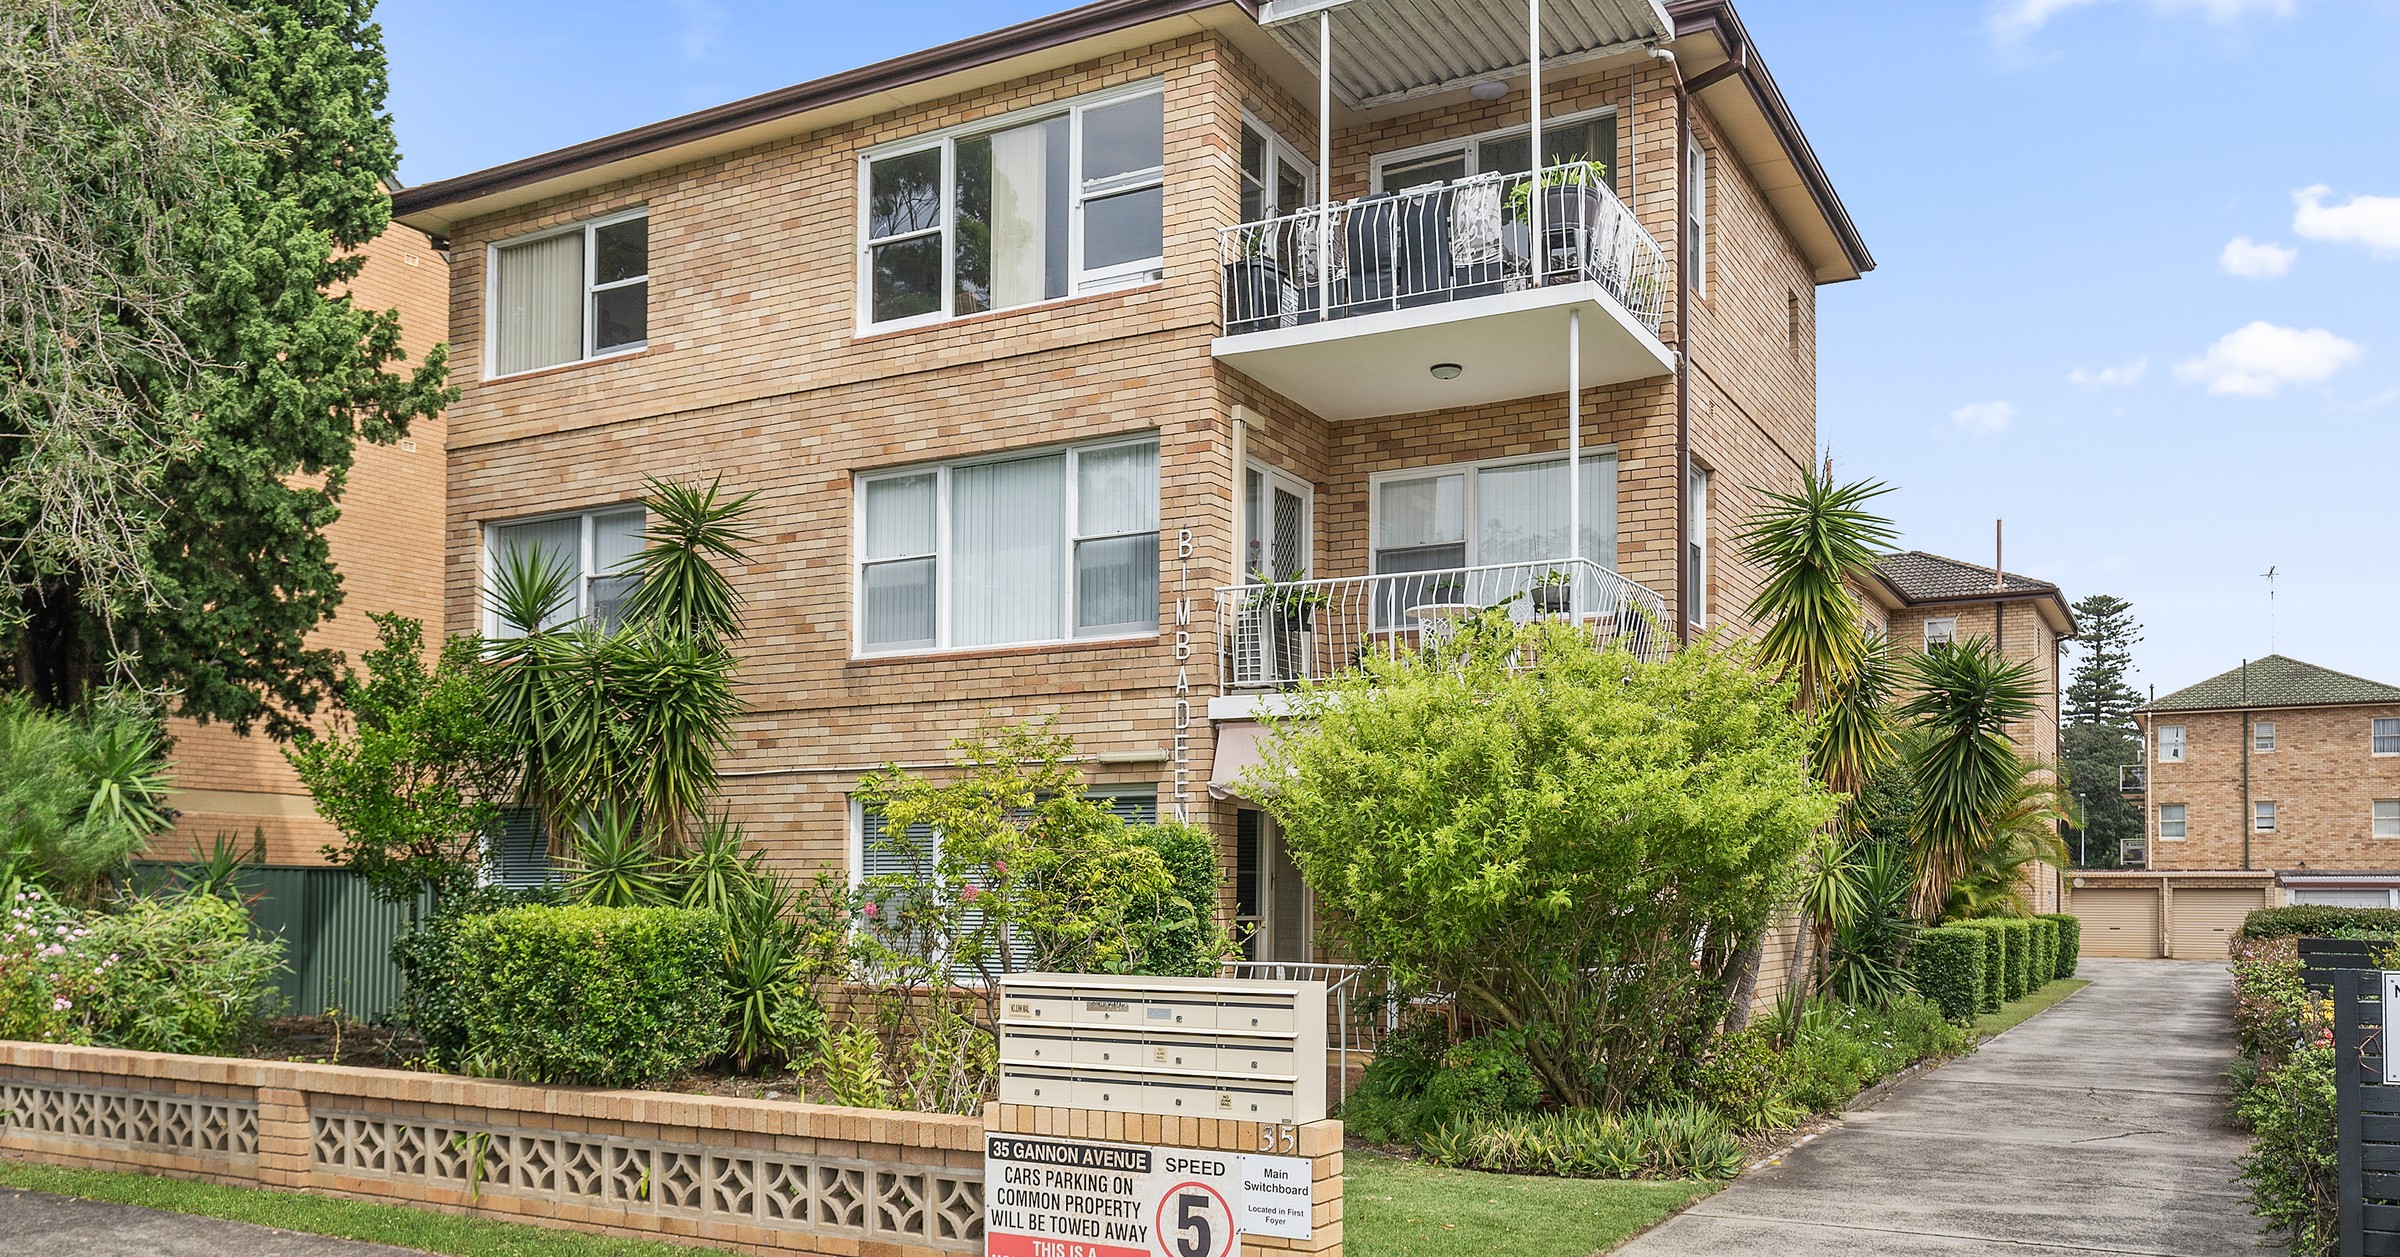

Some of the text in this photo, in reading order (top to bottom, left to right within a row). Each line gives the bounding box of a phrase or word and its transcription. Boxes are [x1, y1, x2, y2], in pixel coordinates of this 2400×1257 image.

[1174, 529, 1193, 828] BIMBADEEN
[1259, 1125, 1294, 1153] 35
[993, 1141, 1147, 1170] 35 GANNON AVENUE
[1165, 1157, 1226, 1176] SPEED
[1005, 1166, 1133, 1195] CARS PARKING ON
[1244, 1180, 1309, 1196] Switchboard
[1264, 1168, 1289, 1180] Main
[997, 1187, 1141, 1219] COMMON PROPERTY
[1248, 1204, 1304, 1217] Located in First
[991, 1209, 1148, 1243] WILL BE TOWED AWAY
[1177, 1193, 1212, 1257] 5
[1265, 1216, 1287, 1225] Foyer
[1032, 1240, 1066, 1257] THIS
[1070, 1245, 1083, 1257] IS
